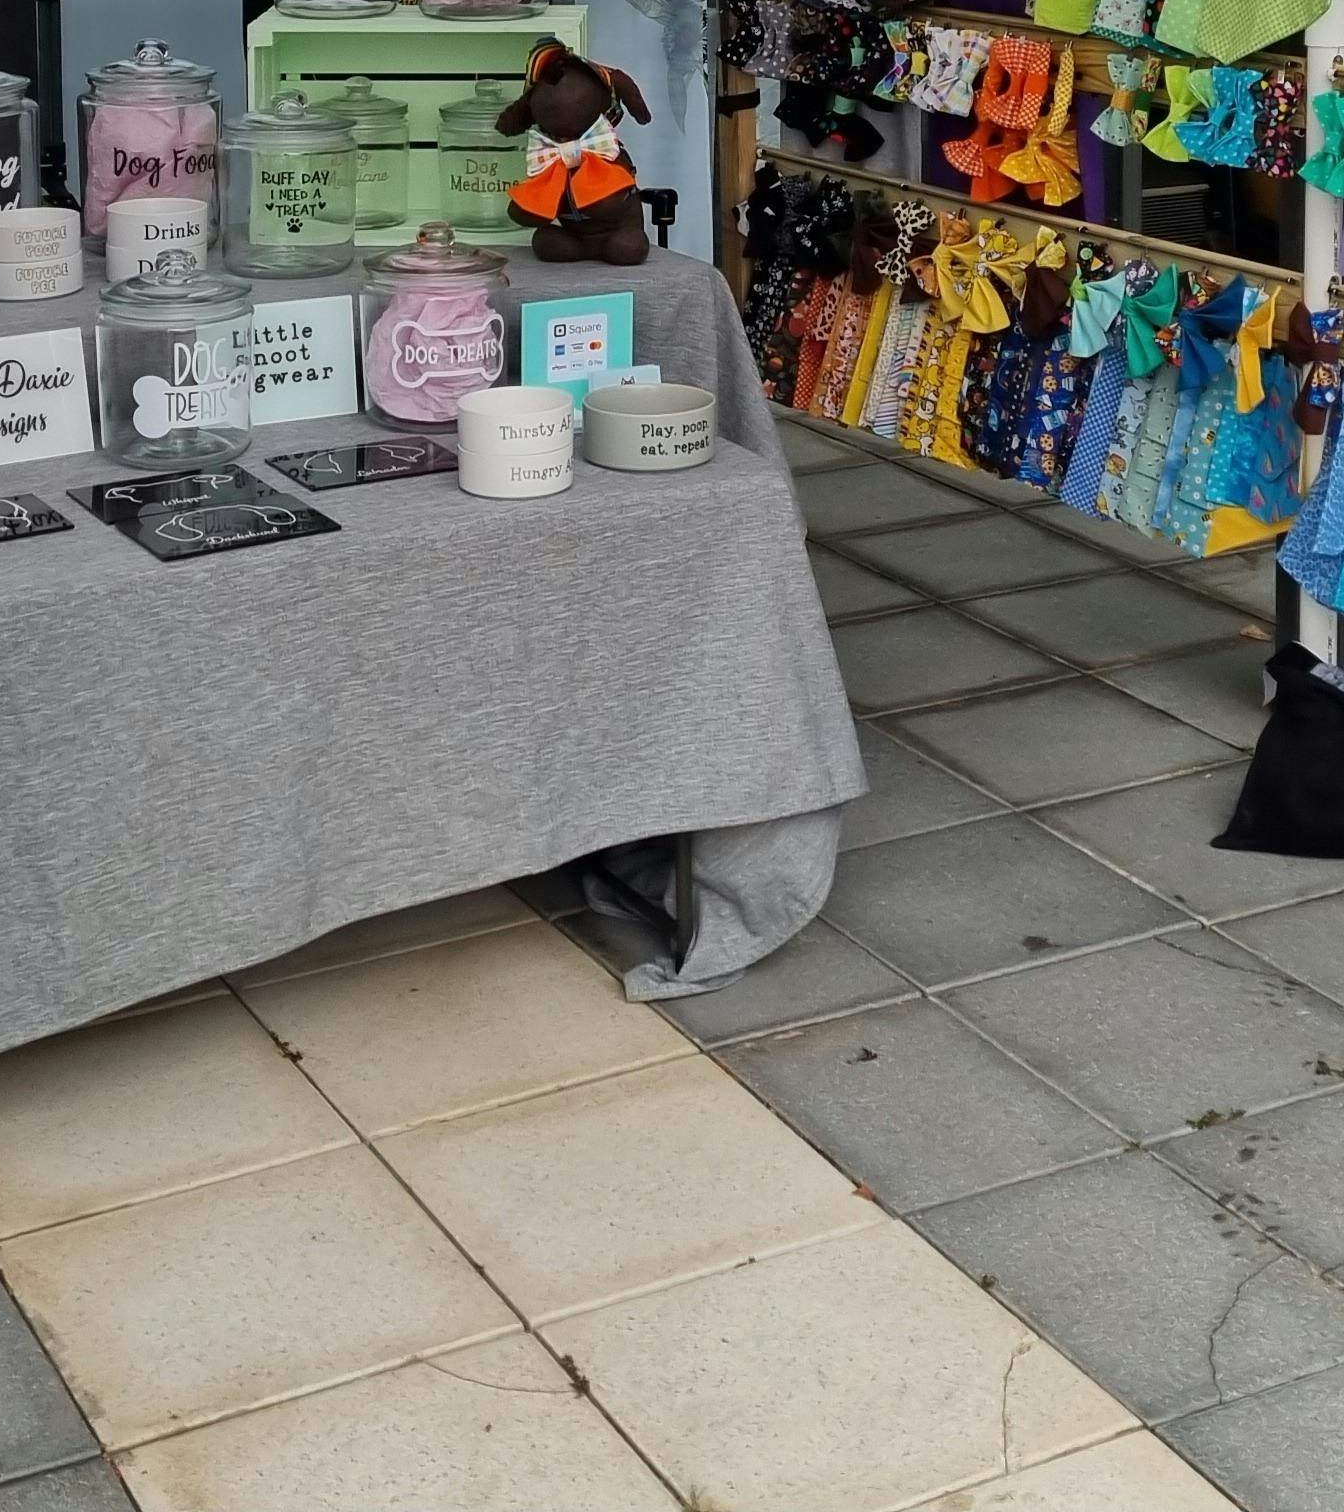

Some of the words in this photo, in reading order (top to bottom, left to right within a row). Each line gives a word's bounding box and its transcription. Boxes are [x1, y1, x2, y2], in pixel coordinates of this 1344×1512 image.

[112, 146, 166, 189] Dog
[465, 158, 499, 176] Dog
[261, 171, 296, 186] RUFF
[301, 169, 330, 186] DAY
[270, 189, 275, 201] I
[279, 188, 309, 201] NEED
[313, 188, 322, 200] A
[275, 203, 318, 219] TREAT
[144, 221, 201, 241] Drinks
[569, 323, 602, 335] Square
[174, 338, 229, 386] DOG
[405, 346, 439, 365] DOG
[446, 340, 498, 364] TREATS
[164, 387, 228, 423] TREATS
[499, 419, 555, 441] Thirsty
[510, 462, 562, 483] Hungry
